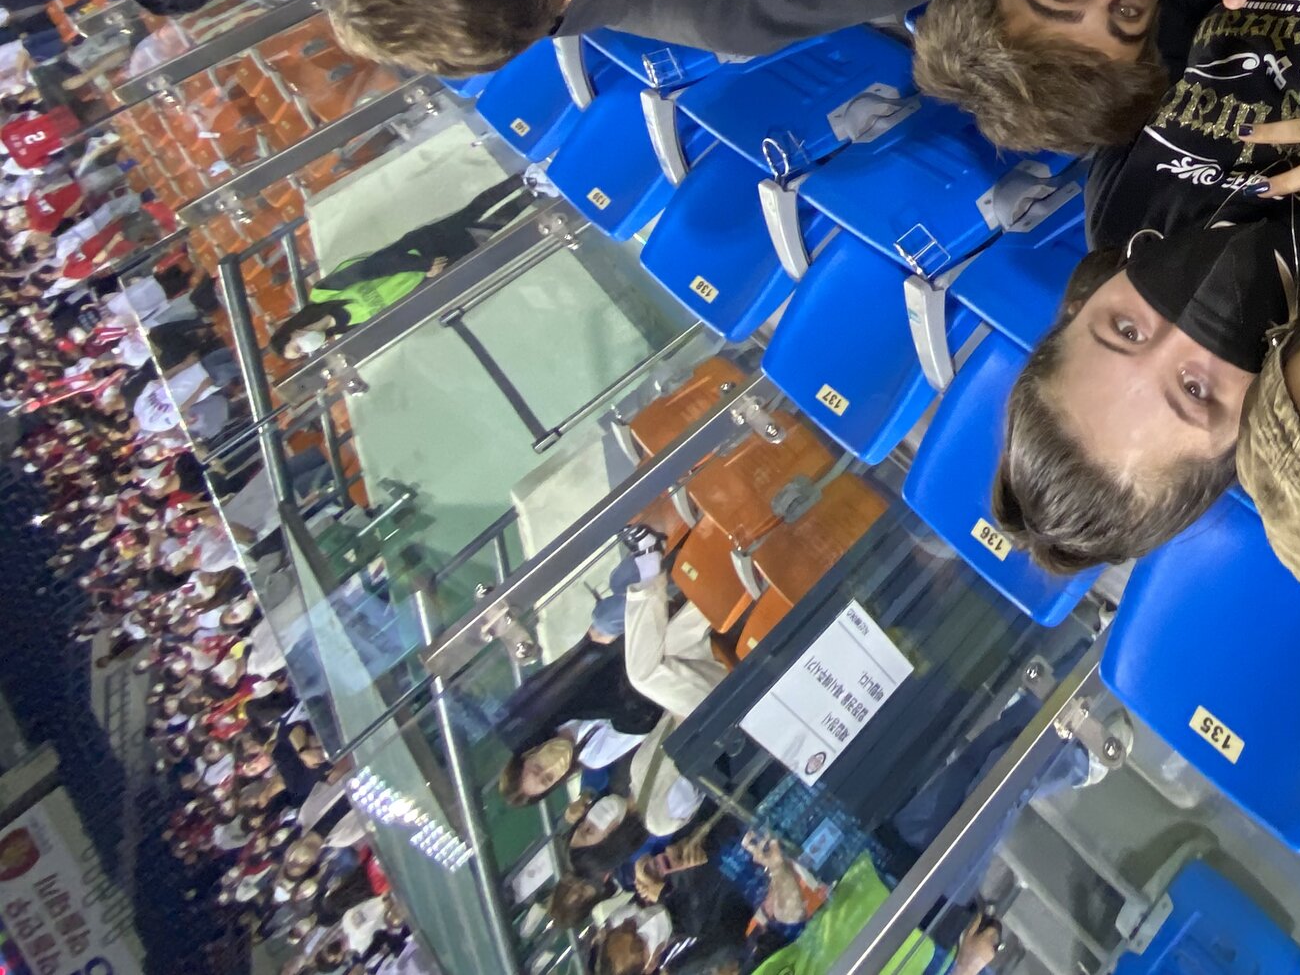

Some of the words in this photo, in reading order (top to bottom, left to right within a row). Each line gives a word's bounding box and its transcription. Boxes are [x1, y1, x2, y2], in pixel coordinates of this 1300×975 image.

[592, 192, 607, 206] 139
[695, 280, 714, 298] 138
[820, 390, 843, 409] 137
[979, 525, 1006, 553] 136
[1199, 715, 1235, 756] 135
